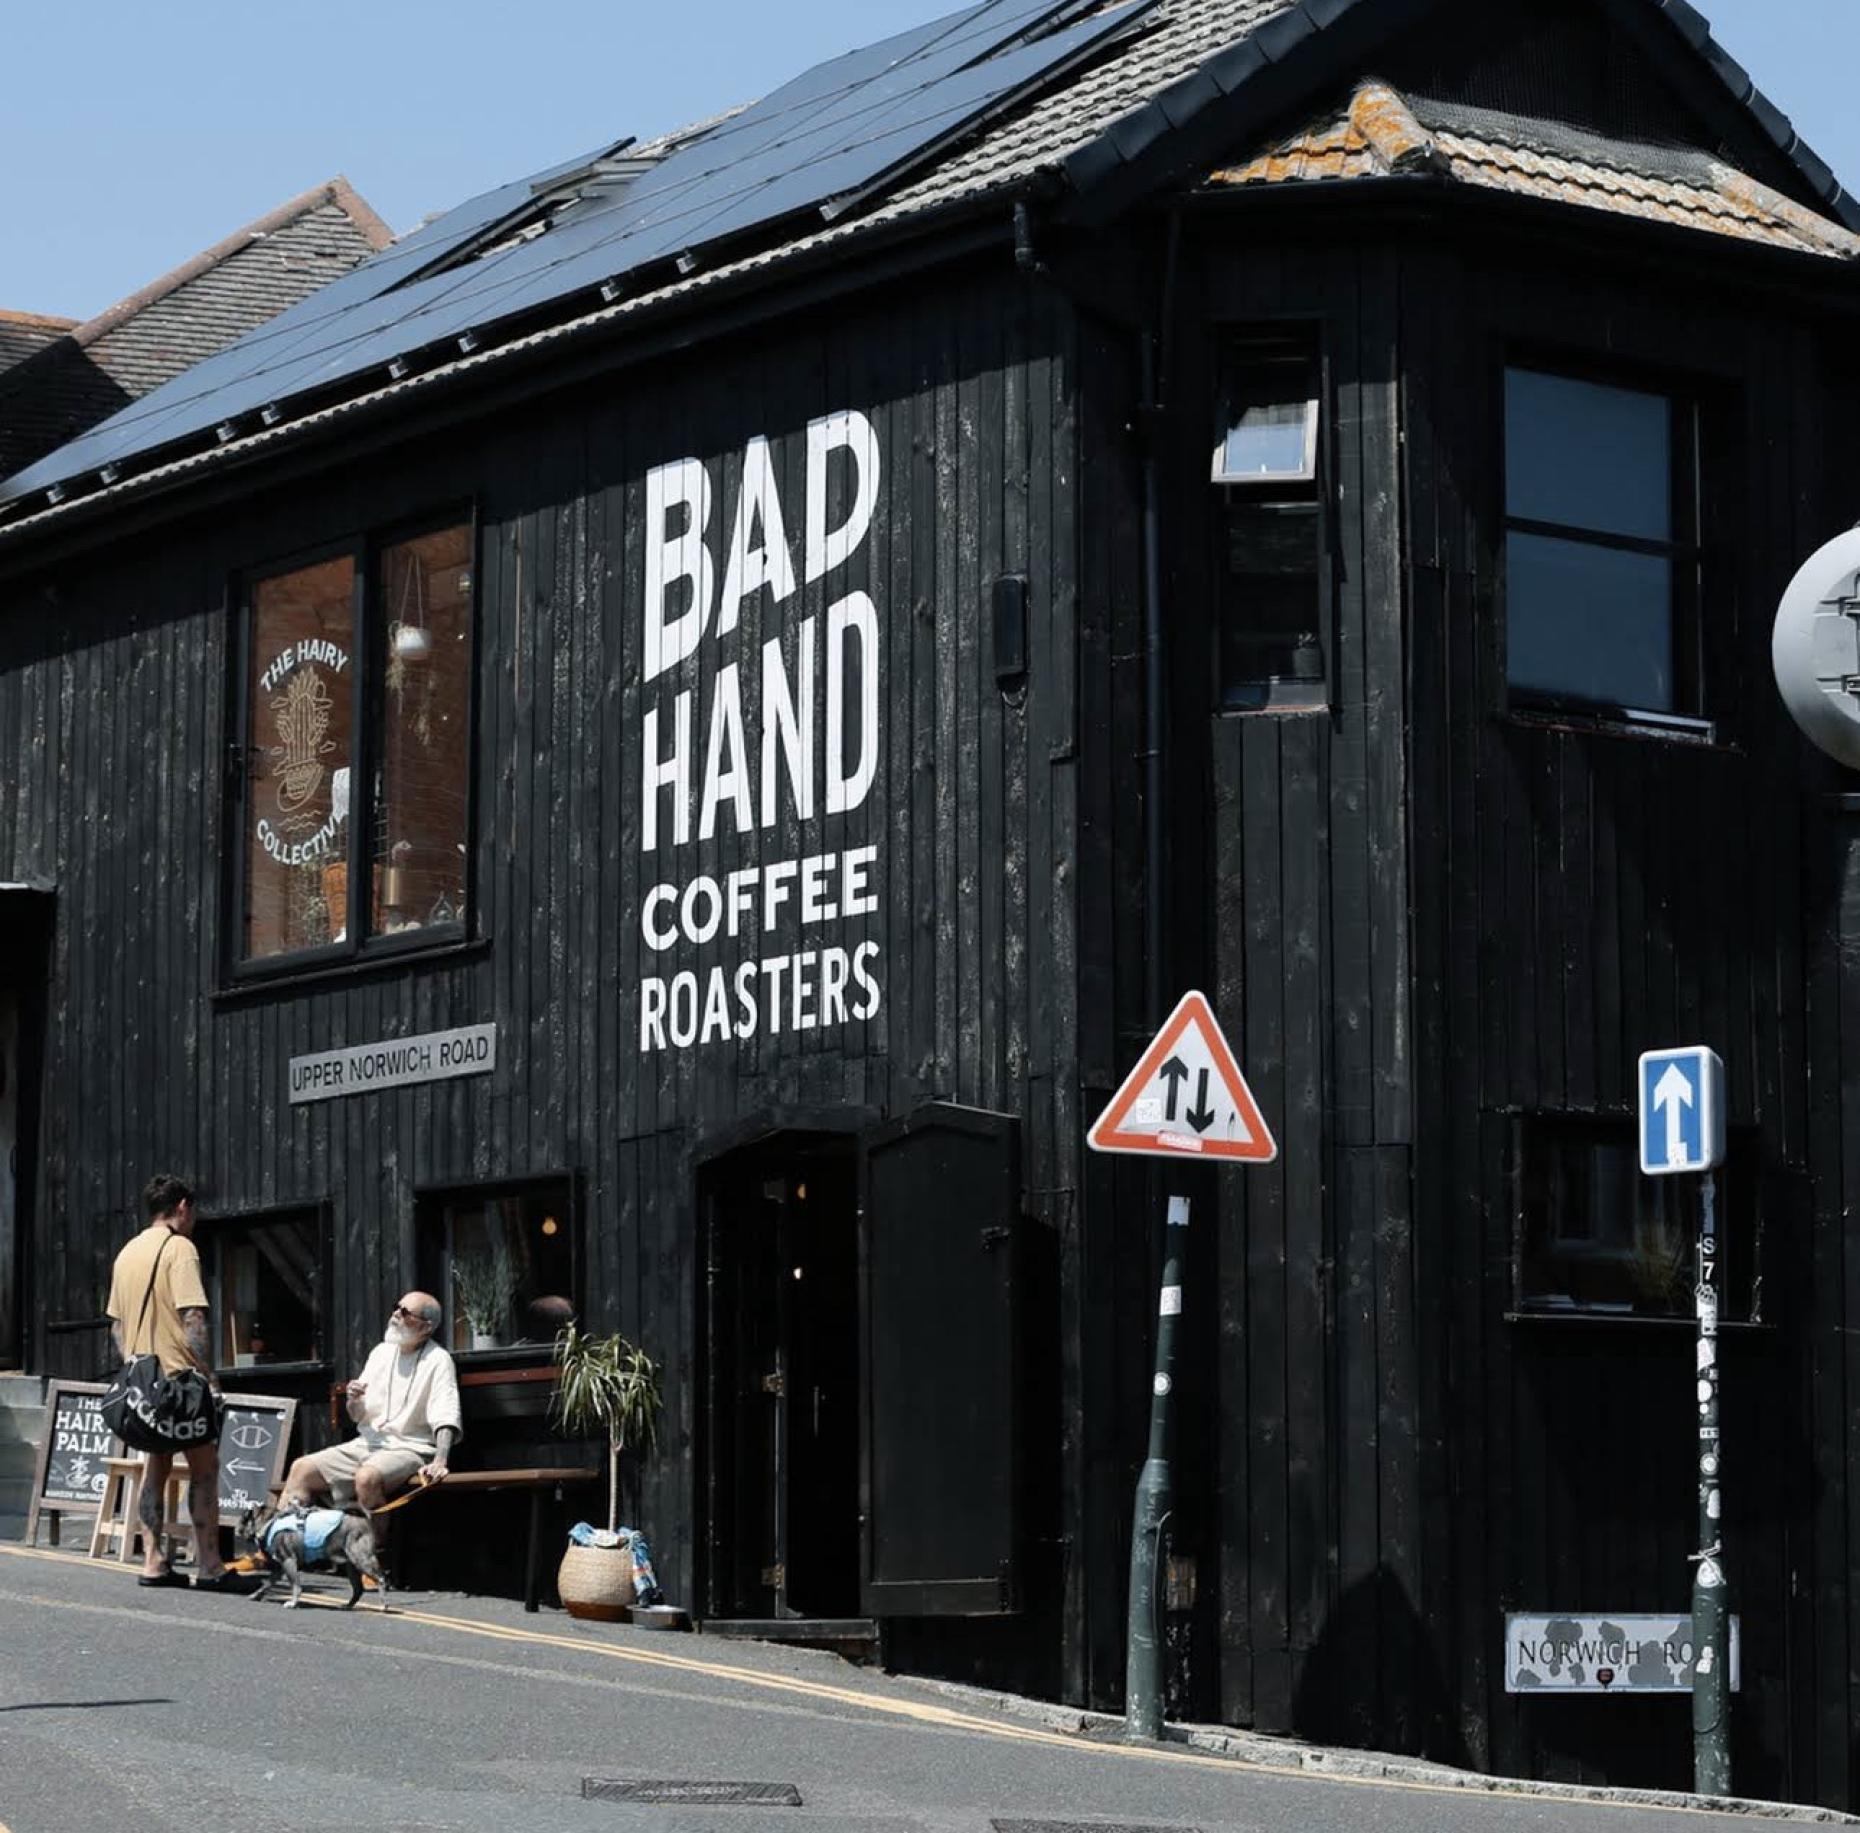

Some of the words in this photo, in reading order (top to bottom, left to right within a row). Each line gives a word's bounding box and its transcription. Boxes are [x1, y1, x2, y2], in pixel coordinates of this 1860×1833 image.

[643, 410, 880, 683] BAD
[260, 649, 295, 693] THE
[297, 638, 348, 674] HAIRY
[642, 590, 879, 852] HAND
[641, 845, 878, 951] COFFEE
[640, 941, 880, 1051] ROASTERS
[292, 1060, 343, 1092] UPPER
[350, 1045, 431, 1081] NORWICH
[439, 1035, 488, 1067] ROAD
[55, 1411, 112, 1433] HAIR
[78, 1397, 102, 1410] THE
[127, 1386, 208, 1440] addas
[56, 1432, 111, 1454] PALM
[1518, 1640, 1641, 1666] NORWICH
[1662, 1640, 1694, 1665] RO
